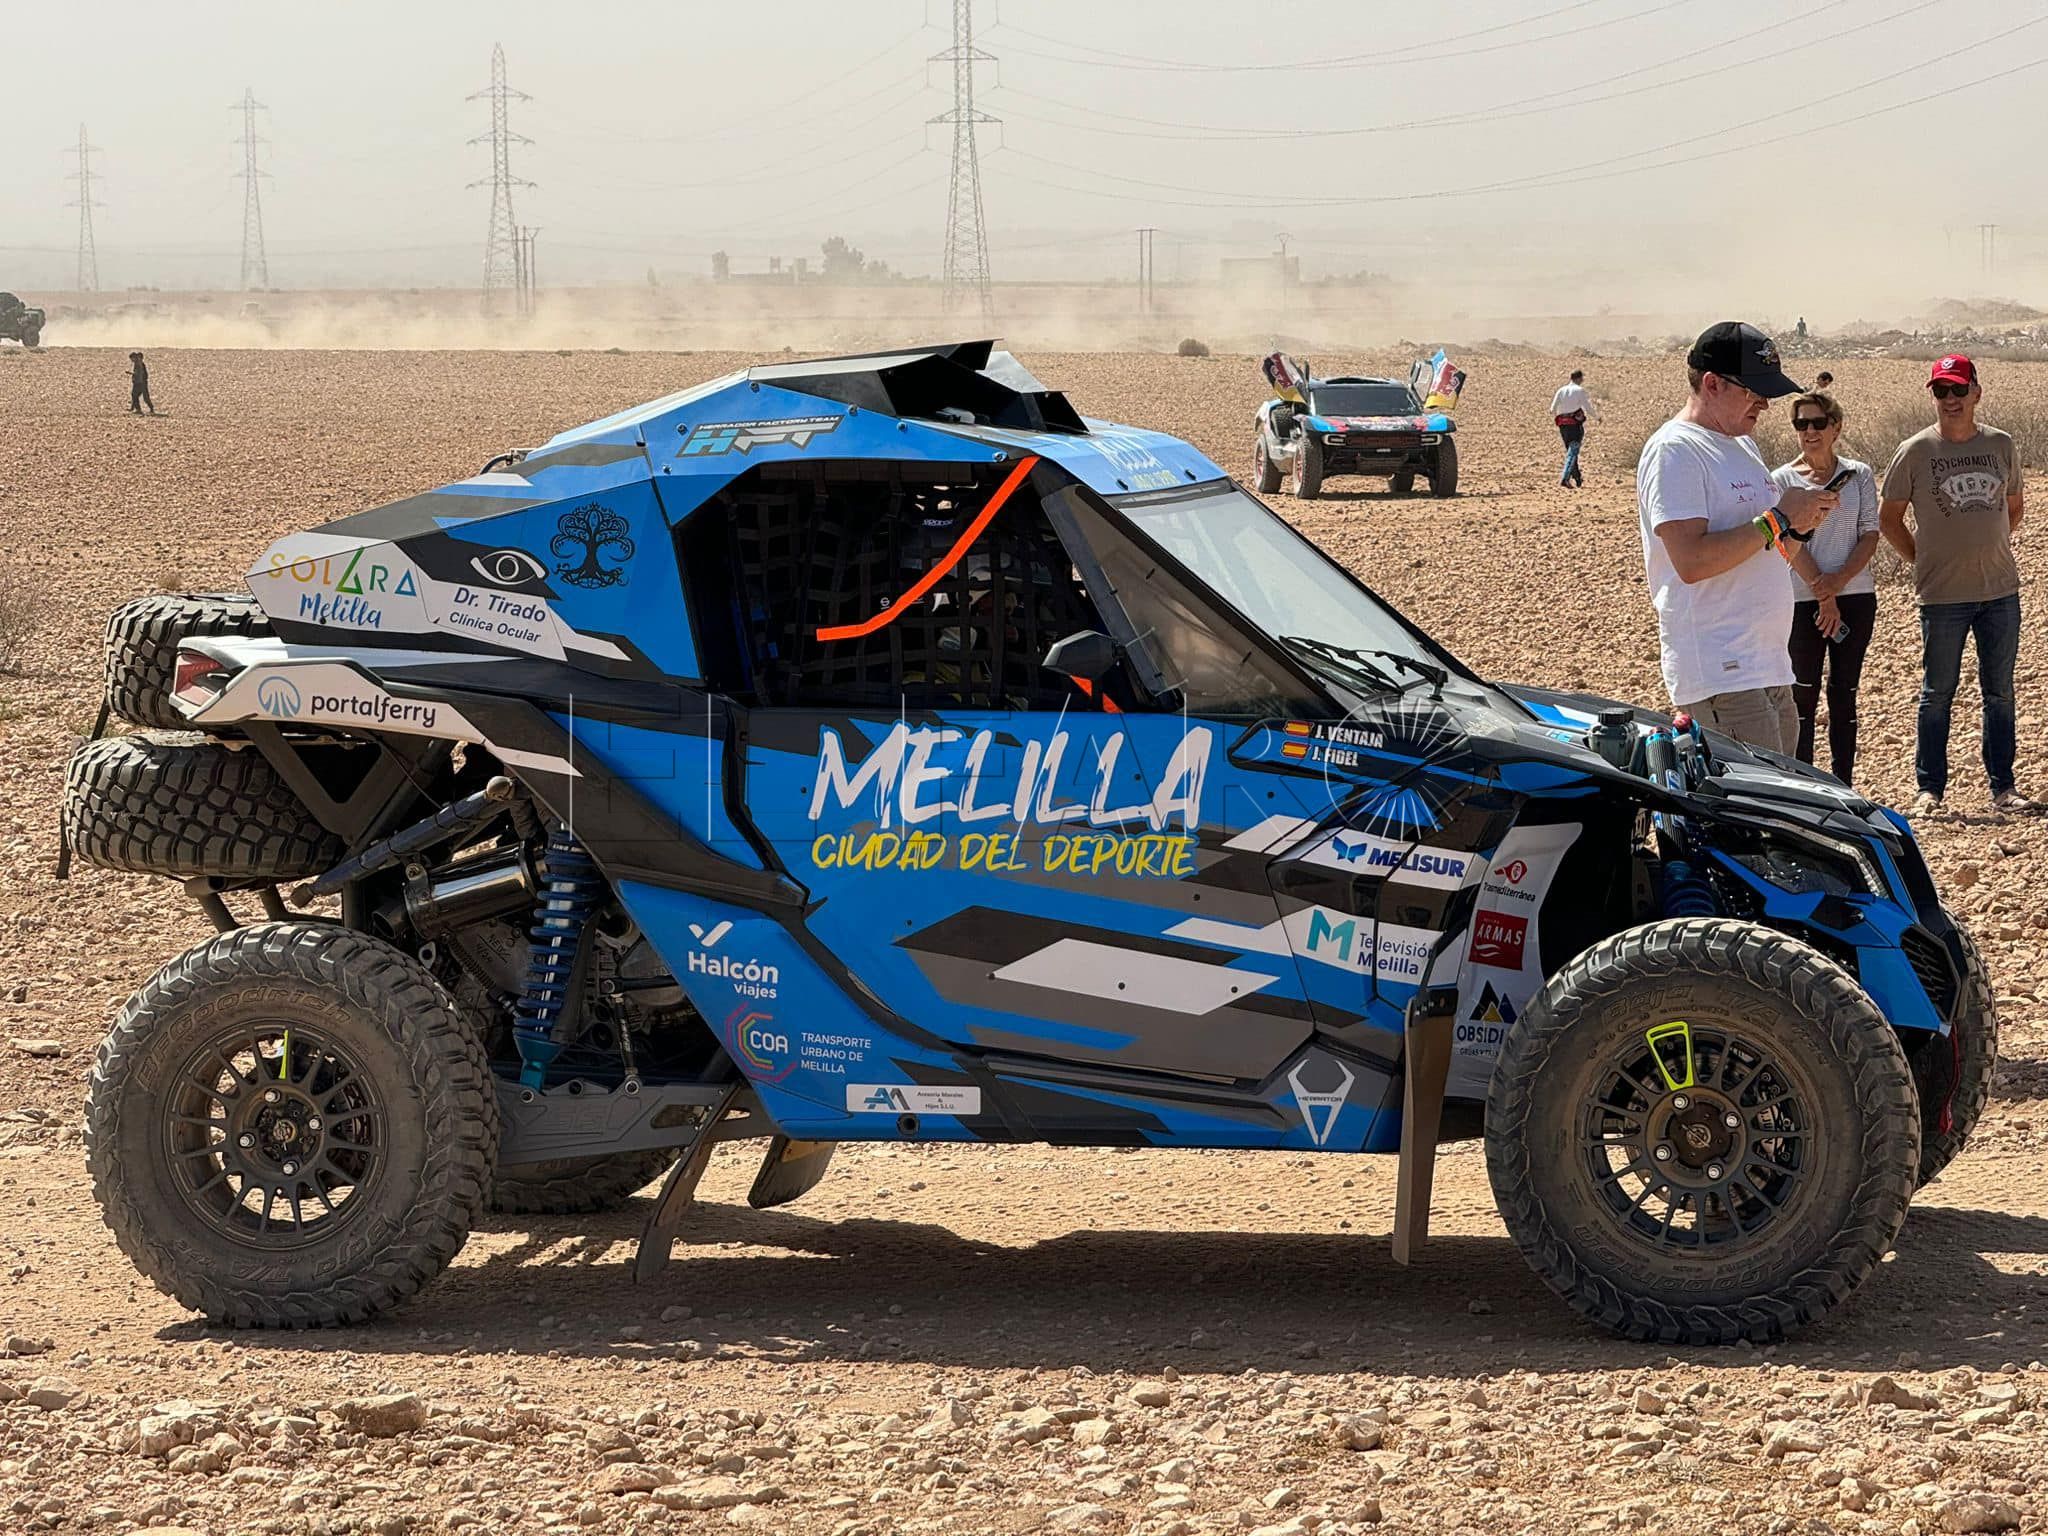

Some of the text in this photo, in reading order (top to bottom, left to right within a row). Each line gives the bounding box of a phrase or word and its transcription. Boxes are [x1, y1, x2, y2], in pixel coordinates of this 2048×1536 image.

[757, 418, 808, 428] FACTORY
[808, 415, 840, 424] TEAM
[299, 592, 382, 628] Melilla
[454, 587, 547, 624] Dr. Tirado
[497, 620, 542, 643] Ocular
[311, 691, 437, 728] portalferry
[1314, 723, 1384, 749] J. VENTAJA
[1311, 745, 1359, 767] J. FIDEL
[808, 724, 1212, 831] MELILLA
[811, 833, 1196, 876] CIUDAD DEL DEPORTE
[1367, 847, 1466, 879] MELISUR
[1476, 923, 1523, 945] ARMAS
[688, 951, 779, 984] Halcón
[1357, 951, 1419, 975] Melilla
[734, 982, 778, 999] viajes
[750, 1029, 788, 1054] COA
[801, 1032, 872, 1049] TRANSPORTE
[1457, 1025, 1505, 1045] OBSIDI
[800, 1046, 864, 1062] URBANO DE
[800, 1060, 846, 1075] MELILLA
